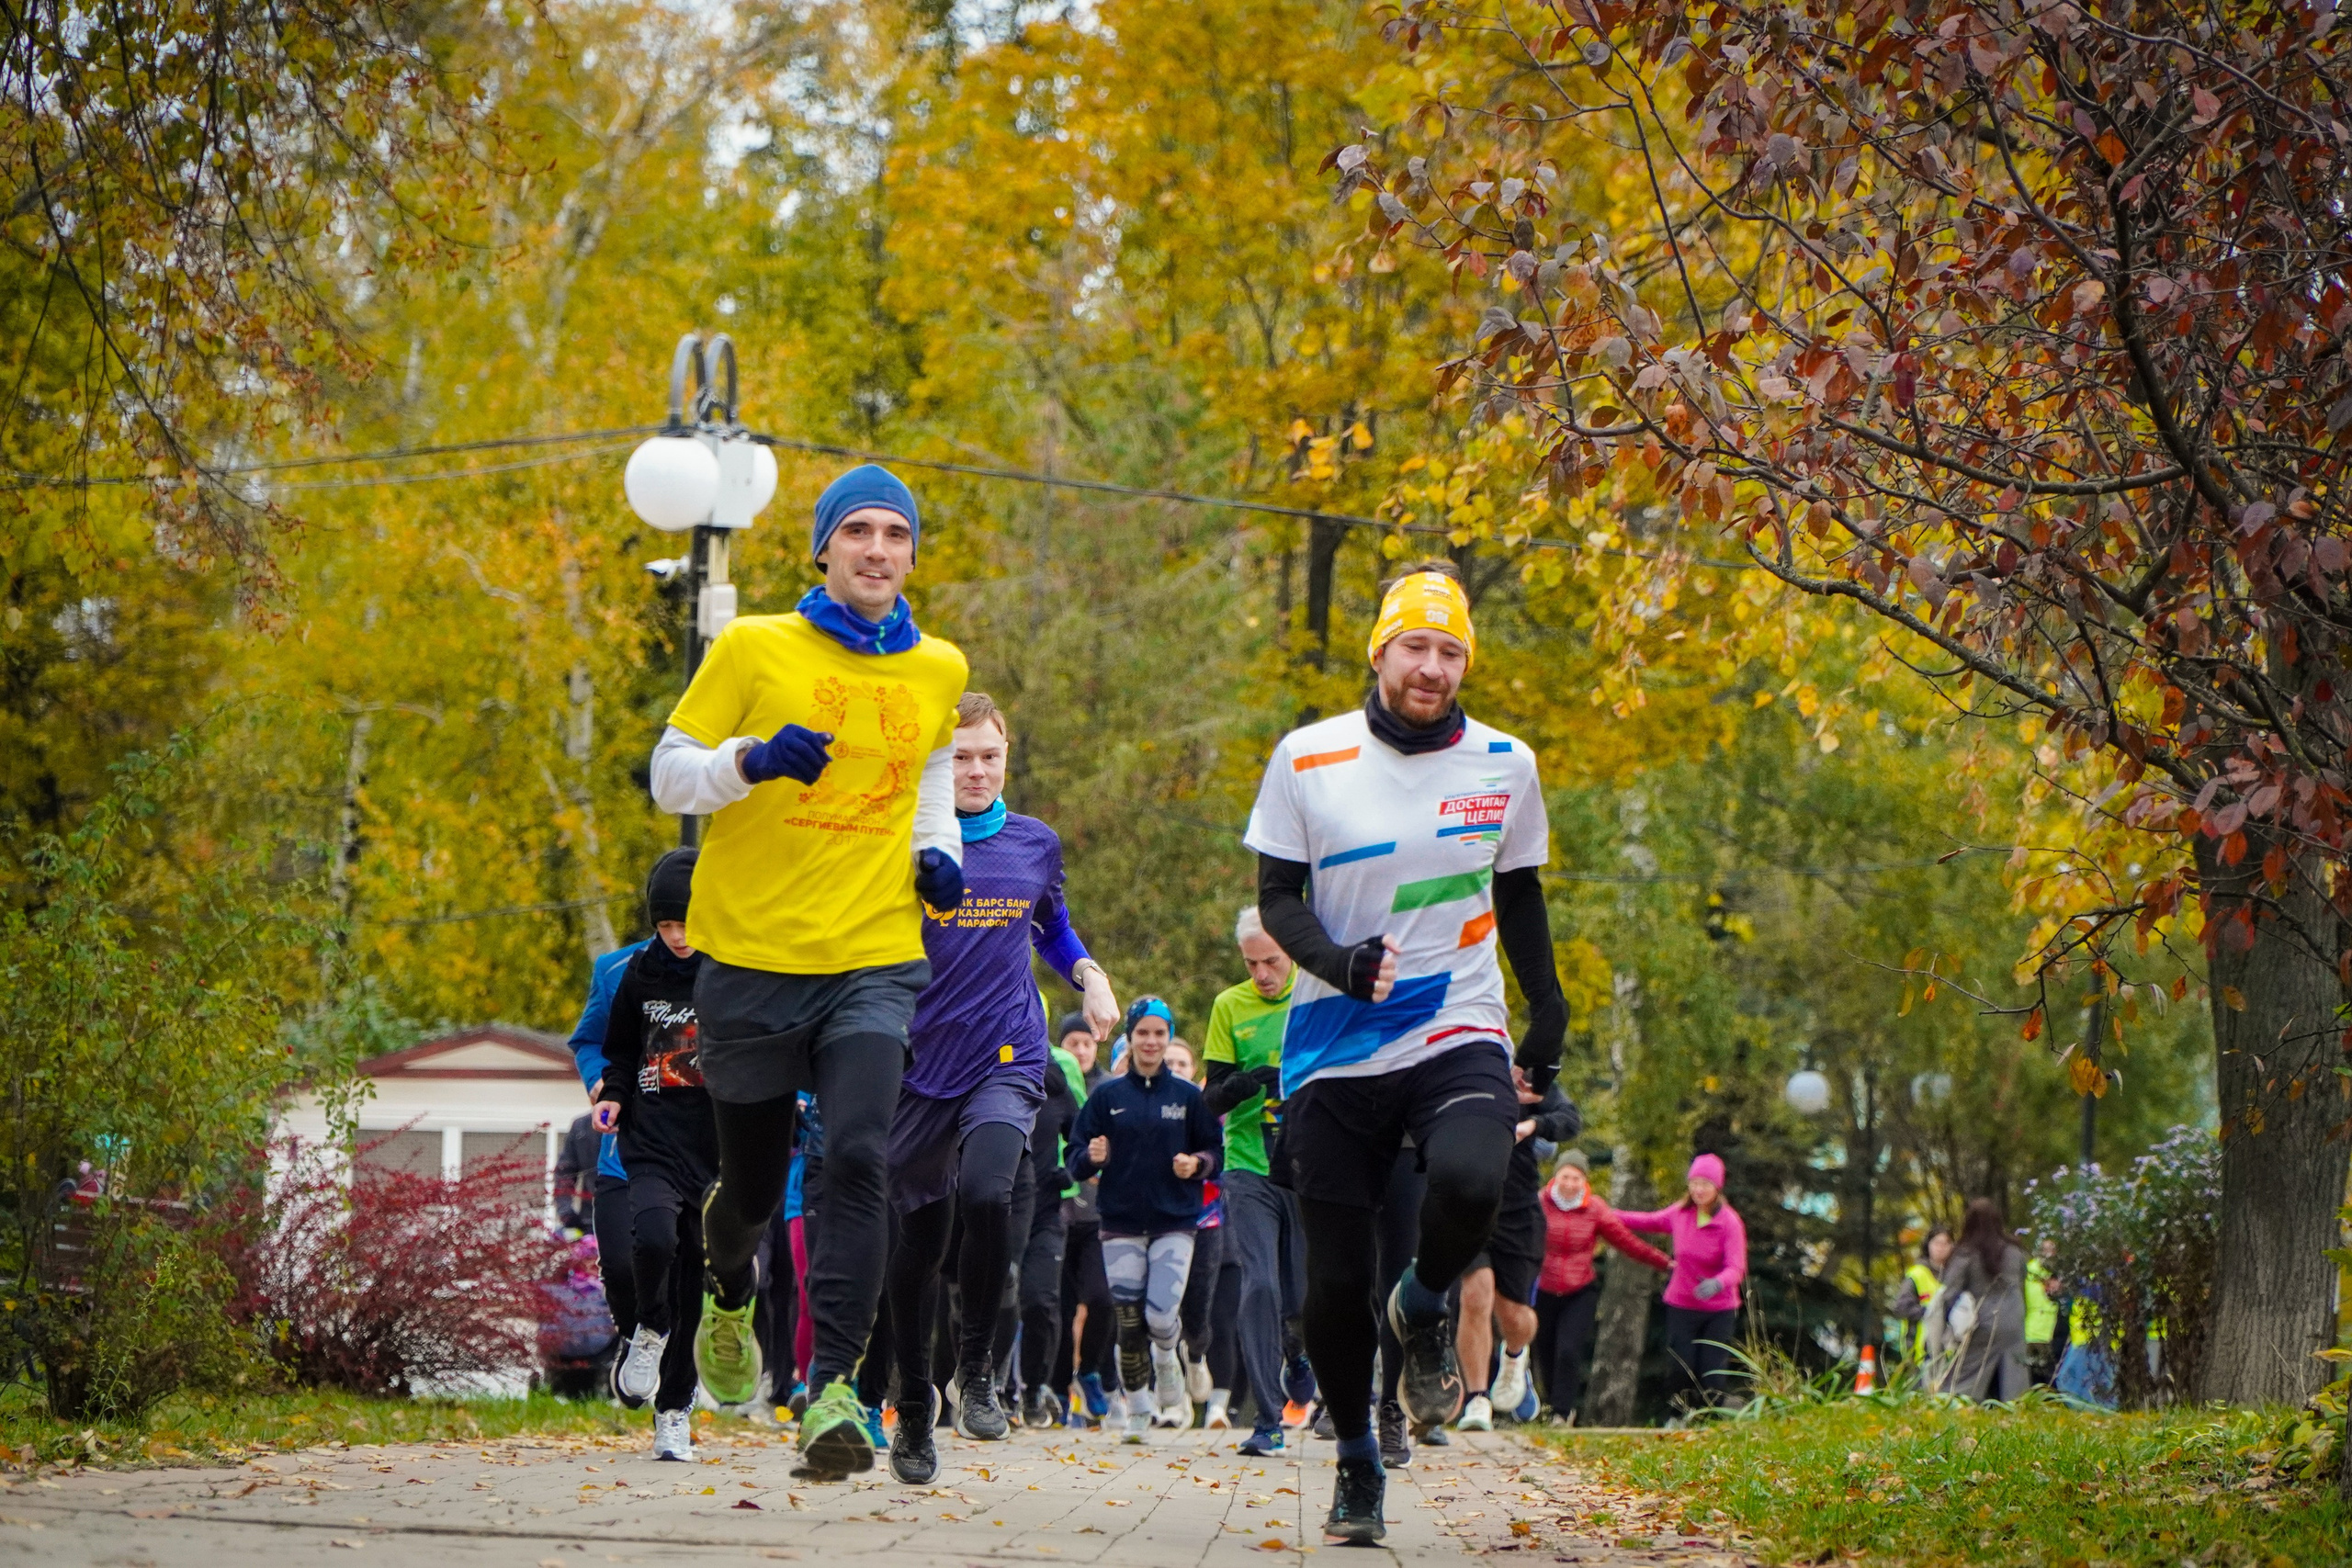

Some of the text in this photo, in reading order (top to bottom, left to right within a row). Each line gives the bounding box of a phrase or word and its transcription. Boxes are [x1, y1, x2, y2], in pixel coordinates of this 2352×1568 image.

[1444, 796, 1507, 814] ДОСТИГАЯ
[808, 810, 881, 826] ПОЛУМАРАФОН
[1466, 809, 1503, 824] ЦЕЛИ!
[784, 817, 858, 832] «СЕРГИЕВЫМ
[825, 832, 860, 845] 2017
[976, 898, 1004, 908] БАРС
[1006, 899, 1031, 908] БАНК
[958, 908, 1023, 918] КАЗАНСКИЙ
[957, 919, 1009, 928] МАРАФОН
[650, 1004, 696, 1029] Night
